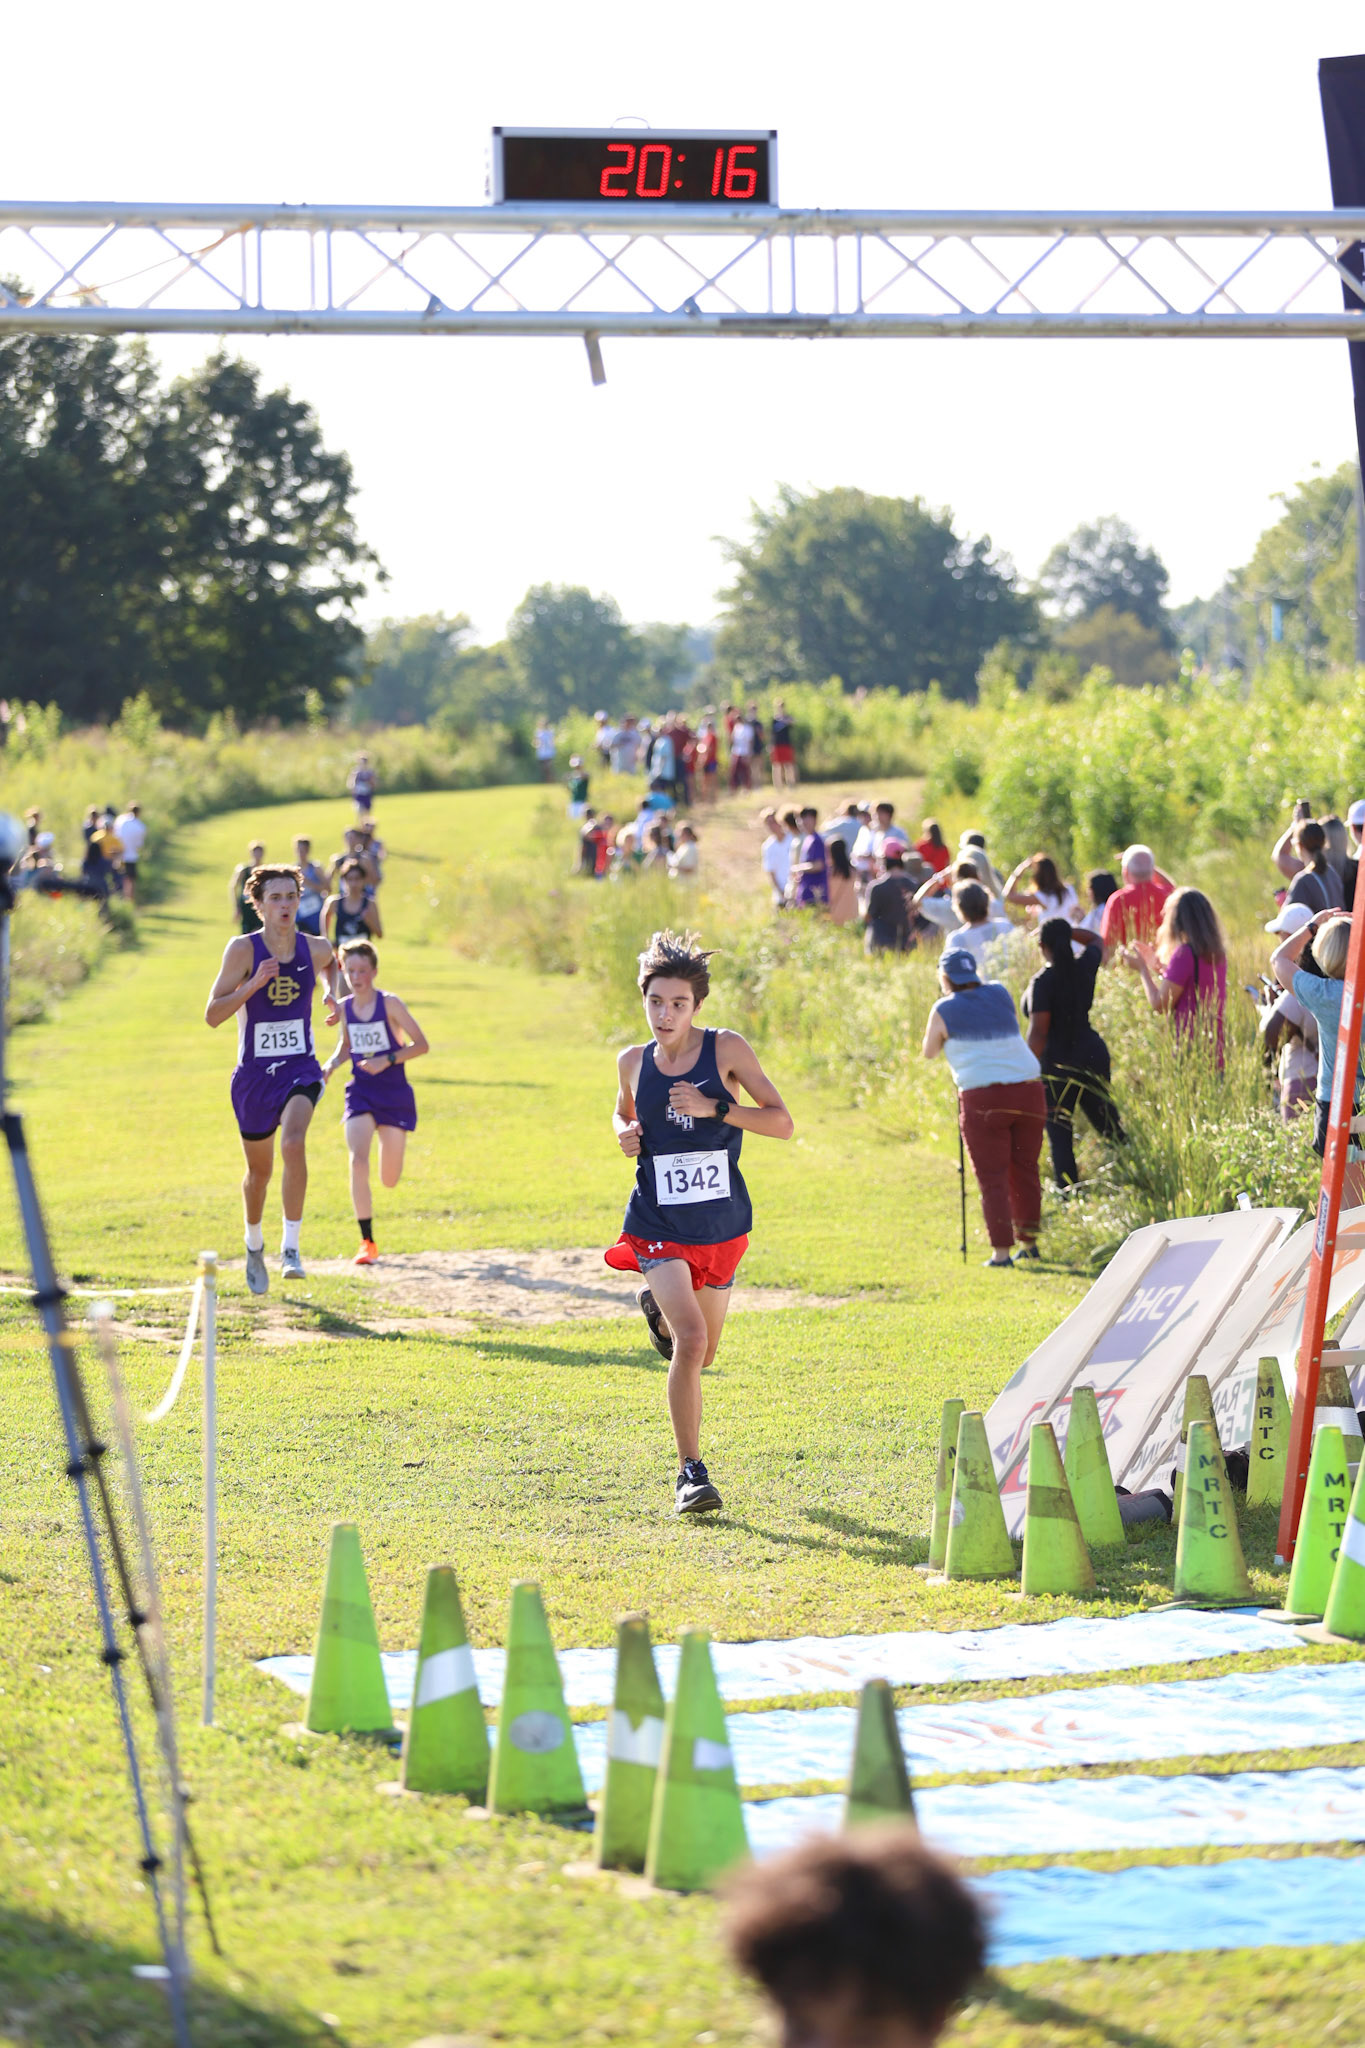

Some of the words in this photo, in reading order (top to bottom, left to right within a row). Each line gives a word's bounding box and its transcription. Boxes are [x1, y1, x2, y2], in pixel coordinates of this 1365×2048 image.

[600, 143, 758, 198] 20:16
[261, 1030, 298, 1049] 2135
[353, 1031, 382, 1047] 2102
[664, 1165, 720, 1194] 1342
[1257, 1385, 1275, 1460] MRTC
[1198, 1454, 1228, 1539] MRTC
